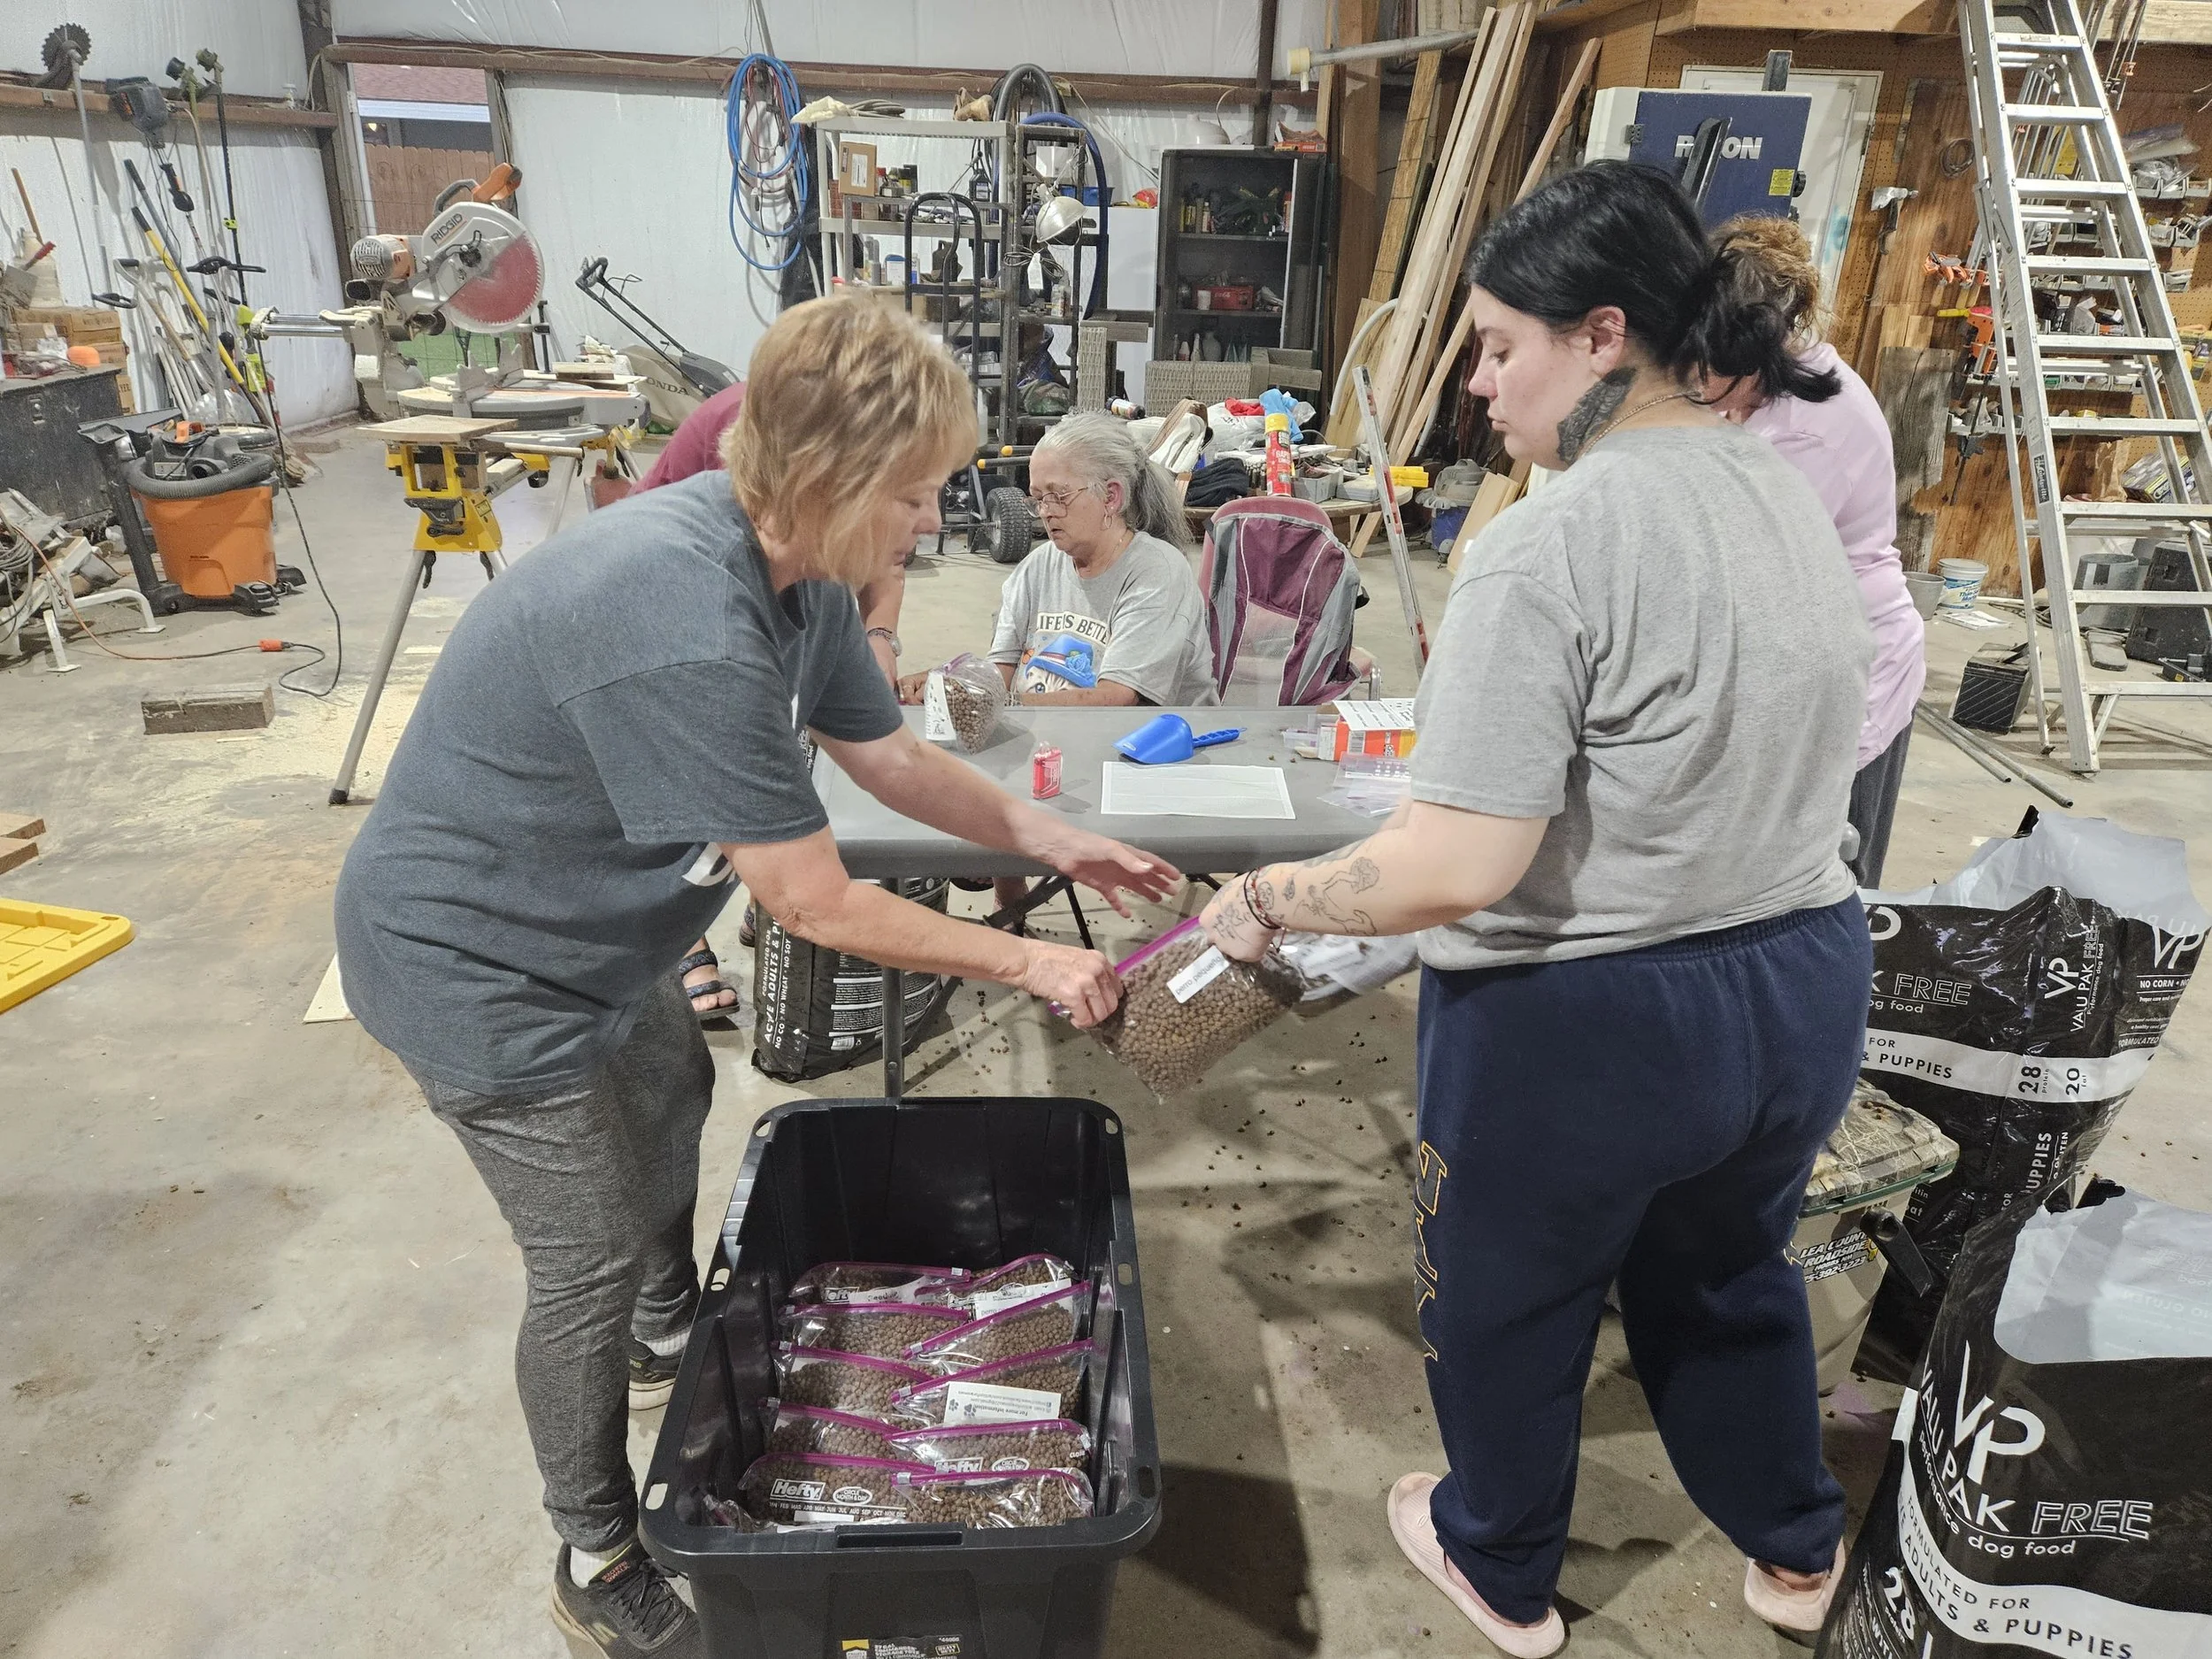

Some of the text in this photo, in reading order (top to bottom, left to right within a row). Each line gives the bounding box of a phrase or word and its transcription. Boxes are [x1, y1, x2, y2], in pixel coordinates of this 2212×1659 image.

[1674, 134, 1763, 159] RON
[431, 213, 463, 244] RIDGID
[645, 377, 690, 396] ONDA
[1040, 615, 1062, 630] IFE
[1076, 618, 1107, 645] BETTE
[772, 939, 780, 949] &
[2152, 924, 2205, 970] VP
[762, 948, 771, 996] FORMULATED
[783, 956, 790, 968] NO
[767, 953, 779, 1002] ADULTS
[780, 976, 789, 1001] WHEAT
[1893, 973, 1972, 1005] FREE
[2044, 957, 2079, 999] VP
[2078, 963, 2094, 990] PAK
[2153, 979, 2174, 988] CORN
[780, 1002, 786, 1015] NO
[1869, 999, 1924, 1014] og food
[774, 1035, 780, 1048] NO
[1869, 1037, 1895, 1048] FOR
[2118, 1036, 2160, 1048] FORMULATED
[1878, 1053, 1953, 1079] PUPPIES
[2018, 1066, 2041, 1094] 28
[2065, 1067, 2079, 1096] 20
[1800, 1231, 1867, 1259] LEA COUNT
[1804, 1239, 1868, 1268] ROADSIDE
[1955, 1340, 2046, 1485] VP
[1921, 1352, 2154, 1540] VALU PAK FREE
[775, 1479, 819, 1500] Hefty
[836, 1493, 853, 1502] MONTH
[1919, 1430, 1960, 1534] performance
[1968, 1535, 2015, 1559] dog
[2025, 1540, 2077, 1555] food
[1908, 1495, 1978, 1604] FORMULATED
[1989, 1597, 2030, 1609] FOR
[1884, 1566, 1916, 1640] 28
[1904, 1534, 1958, 1620] ADULTS
[1973, 1618, 1990, 1633] &
[2006, 1618, 2133, 1659] PUPPIES
